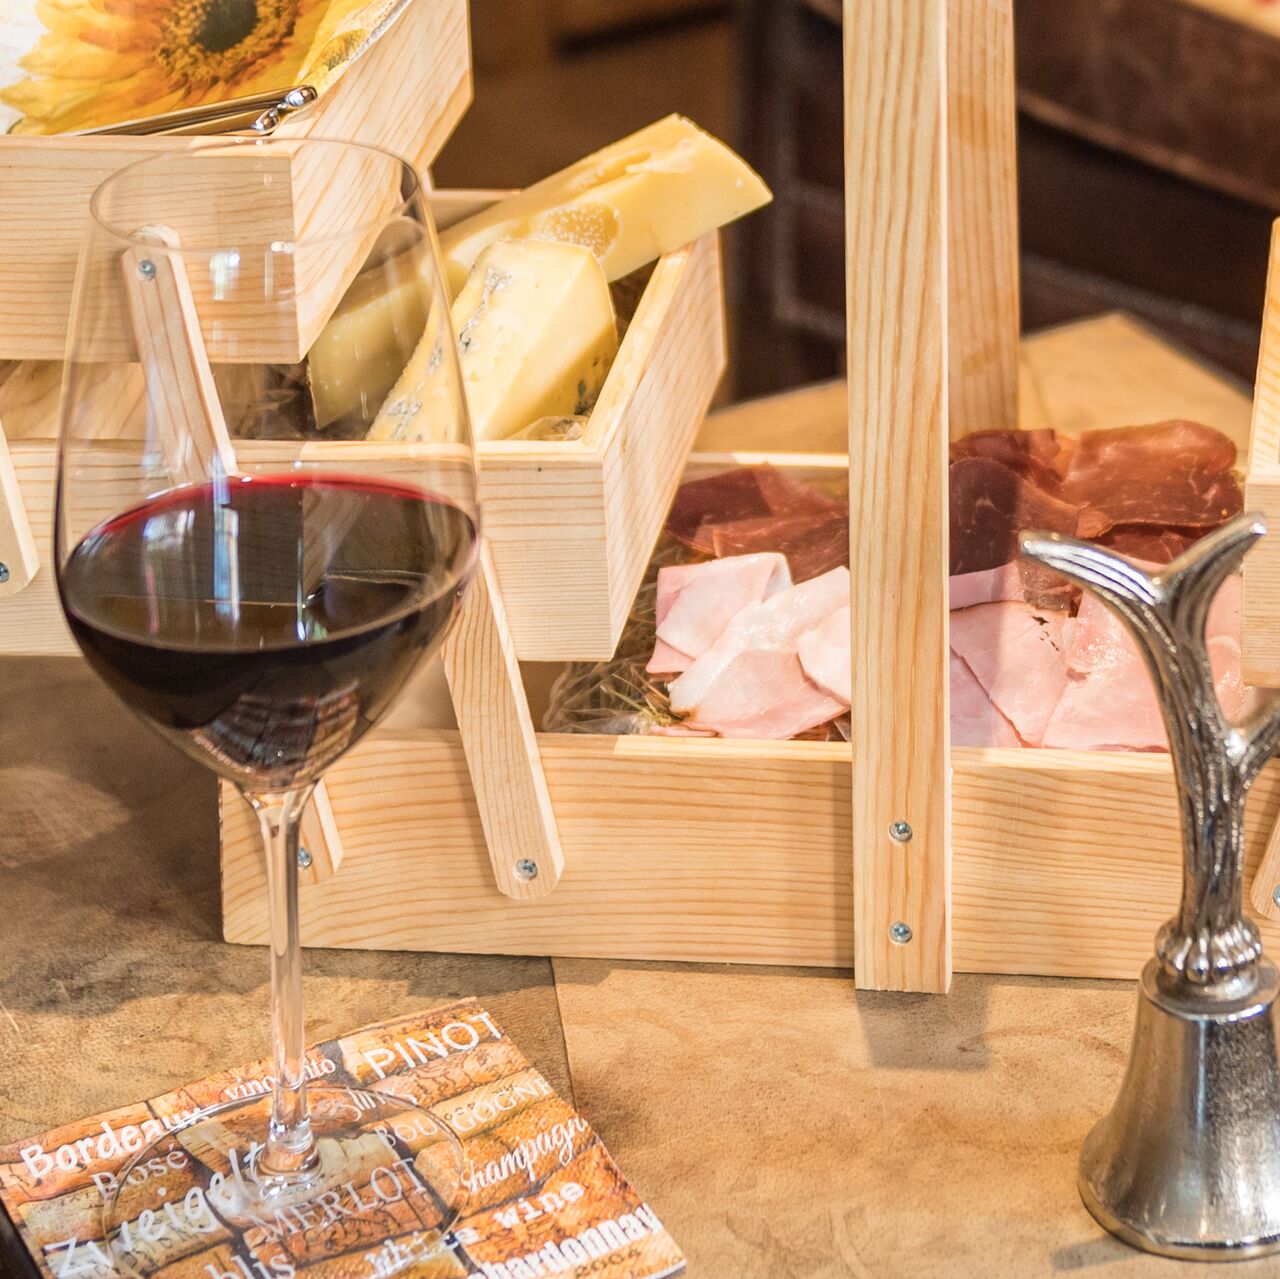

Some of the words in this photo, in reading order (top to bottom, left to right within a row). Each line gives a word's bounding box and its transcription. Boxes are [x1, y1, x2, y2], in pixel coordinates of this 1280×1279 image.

[363, 1011, 503, 1080] PINOT
[248, 1157, 428, 1243] MERLOT
[492, 1180, 586, 1229] wine
